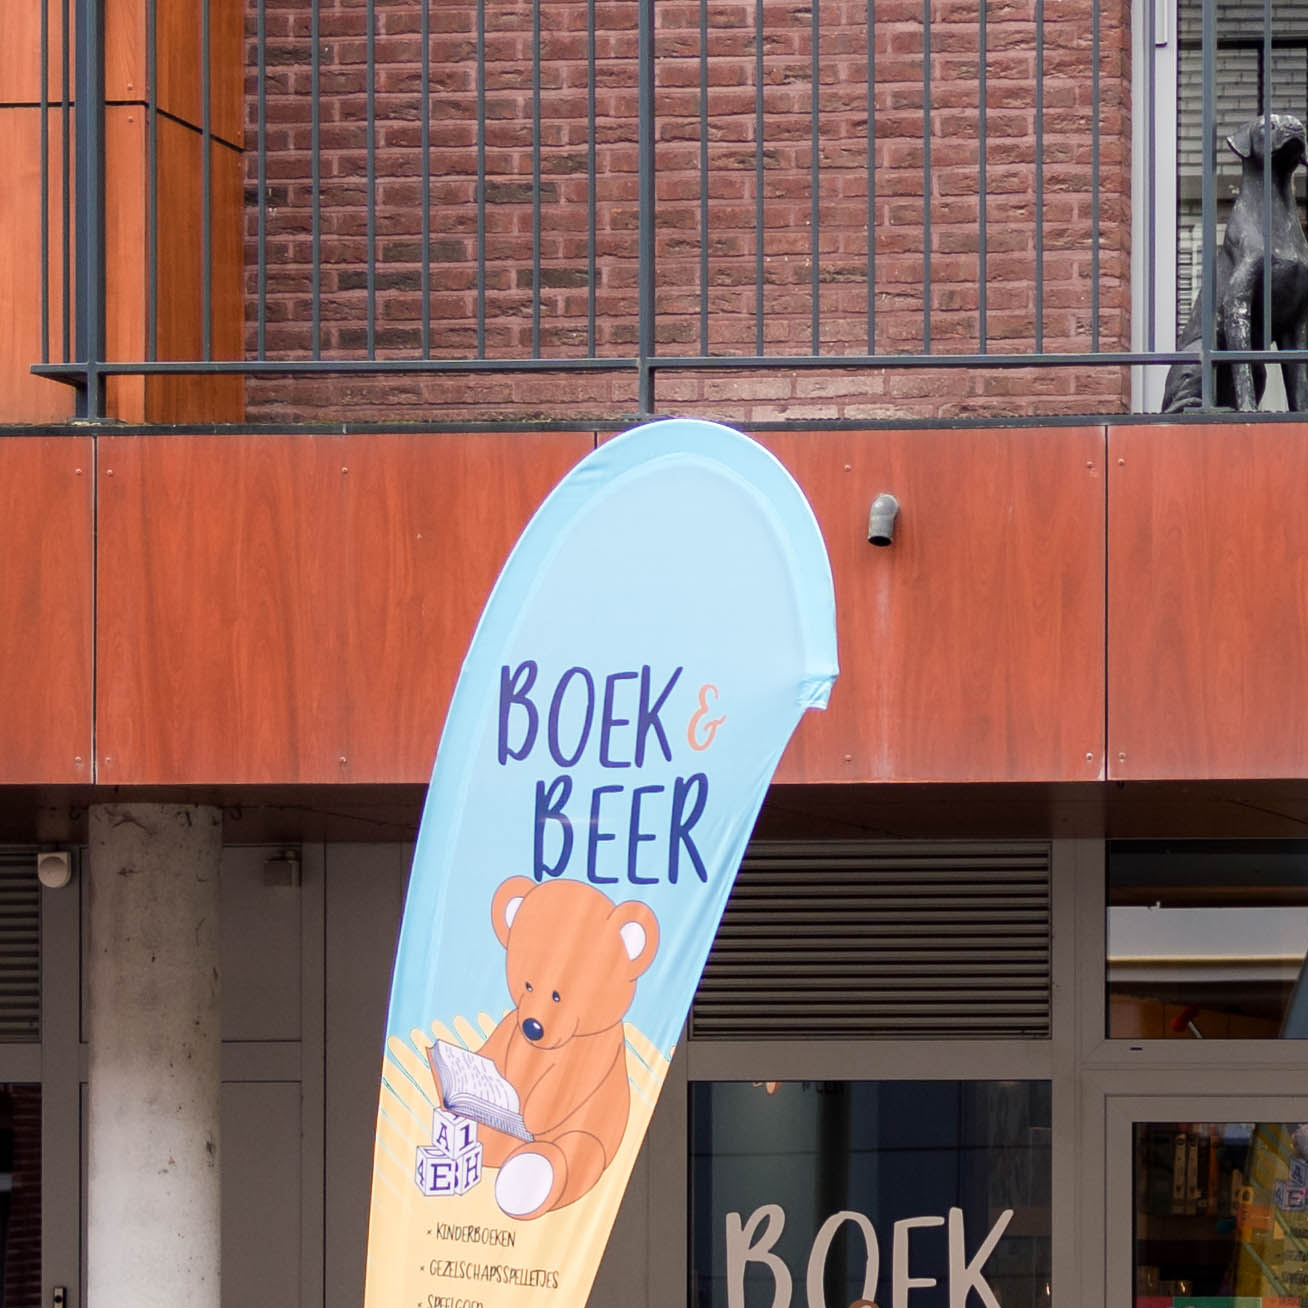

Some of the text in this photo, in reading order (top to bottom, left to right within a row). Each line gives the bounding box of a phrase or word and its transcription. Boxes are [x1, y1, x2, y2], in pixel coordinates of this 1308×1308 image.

[498, 660, 725, 767] BOEK &
[533, 773, 708, 884] BEER
[436, 1222, 516, 1248] KINDERBOEKEN
